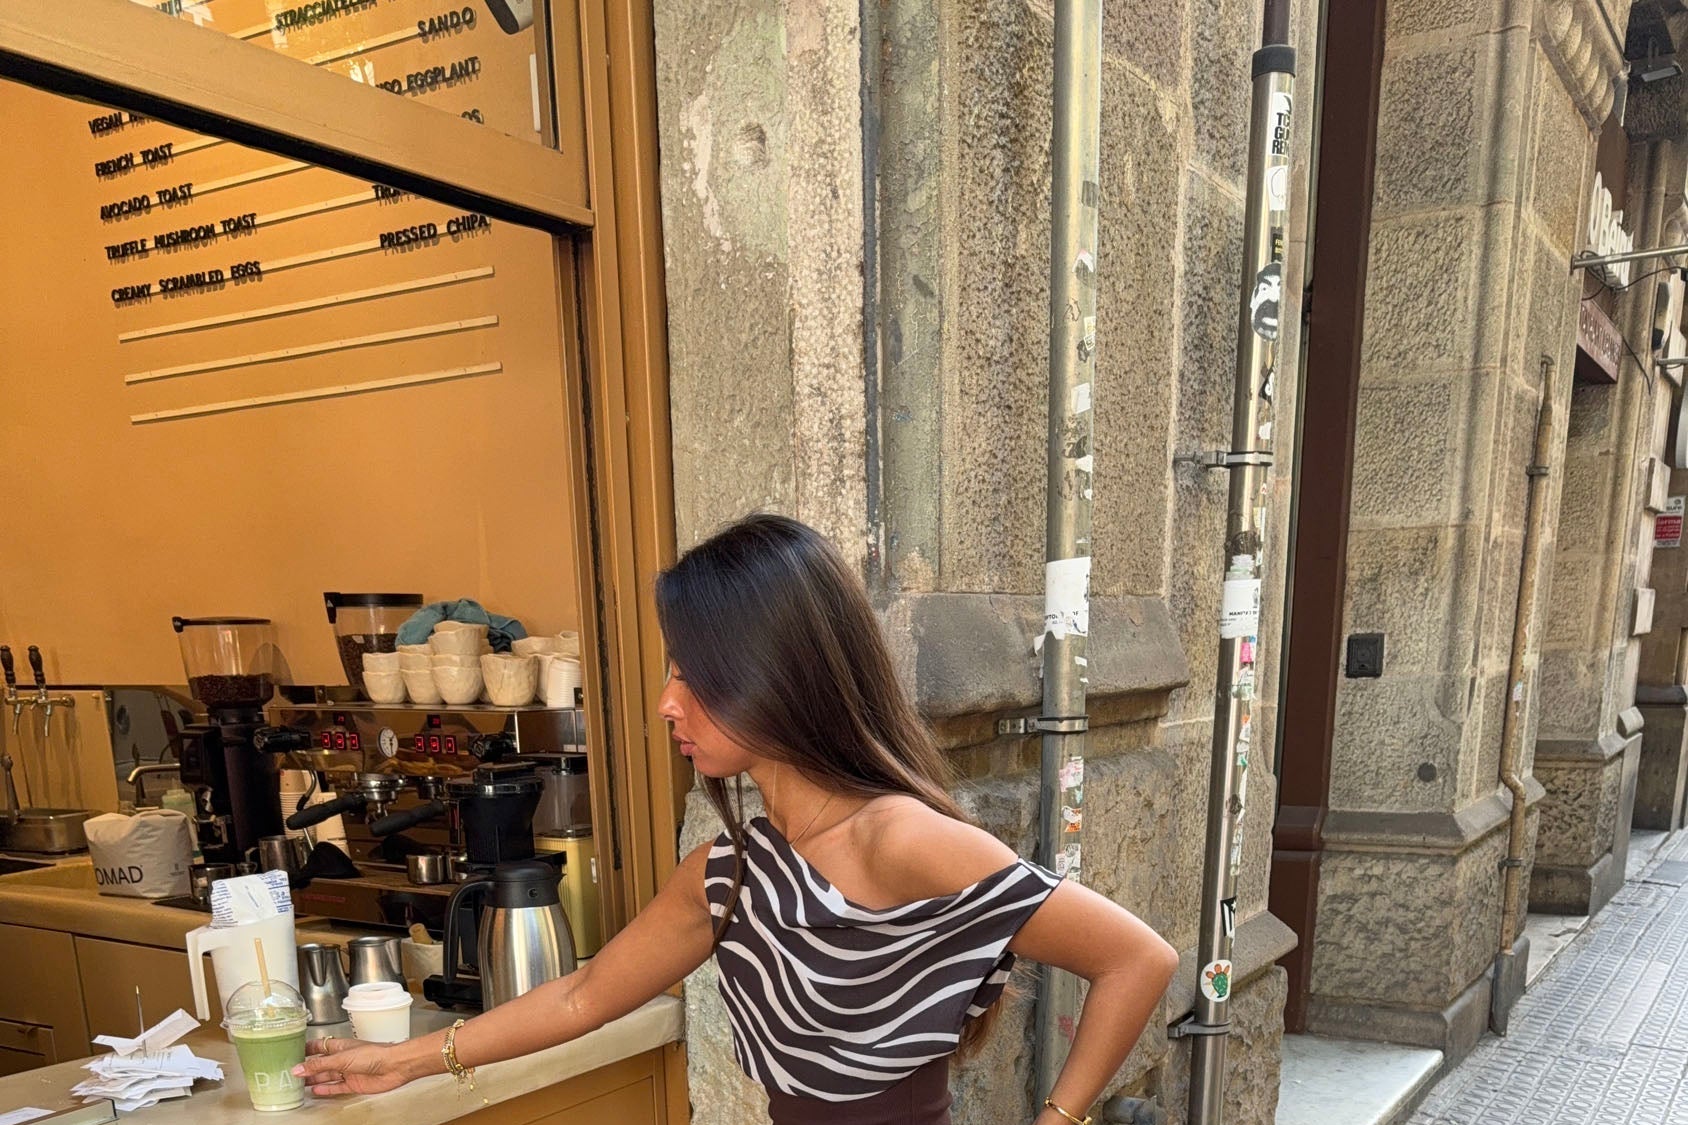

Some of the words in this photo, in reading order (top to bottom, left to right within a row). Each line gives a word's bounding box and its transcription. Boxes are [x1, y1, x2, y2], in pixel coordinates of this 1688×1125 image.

[417, 7, 474, 37] SANDO
[406, 56, 479, 90] EGGPLANT
[88, 111, 122, 134] VEGAN
[95, 152, 134, 177] FRENCH
[140, 143, 174, 164] TOAST
[100, 195, 151, 220] AVOCADO
[156, 183, 193, 204] TOAST
[104, 238, 148, 260] TRUFFLE
[154, 223, 216, 249] MUSHROOM
[220, 212, 257, 235] TOAST
[379, 222, 437, 249] PRESSED
[446, 213, 489, 236] CHIPA
[111, 283, 152, 303] CREAMY
[159, 269, 225, 293] SCRAMBLED
[230, 261, 262, 280] EGGS
[95, 865, 144, 886] OMAD
